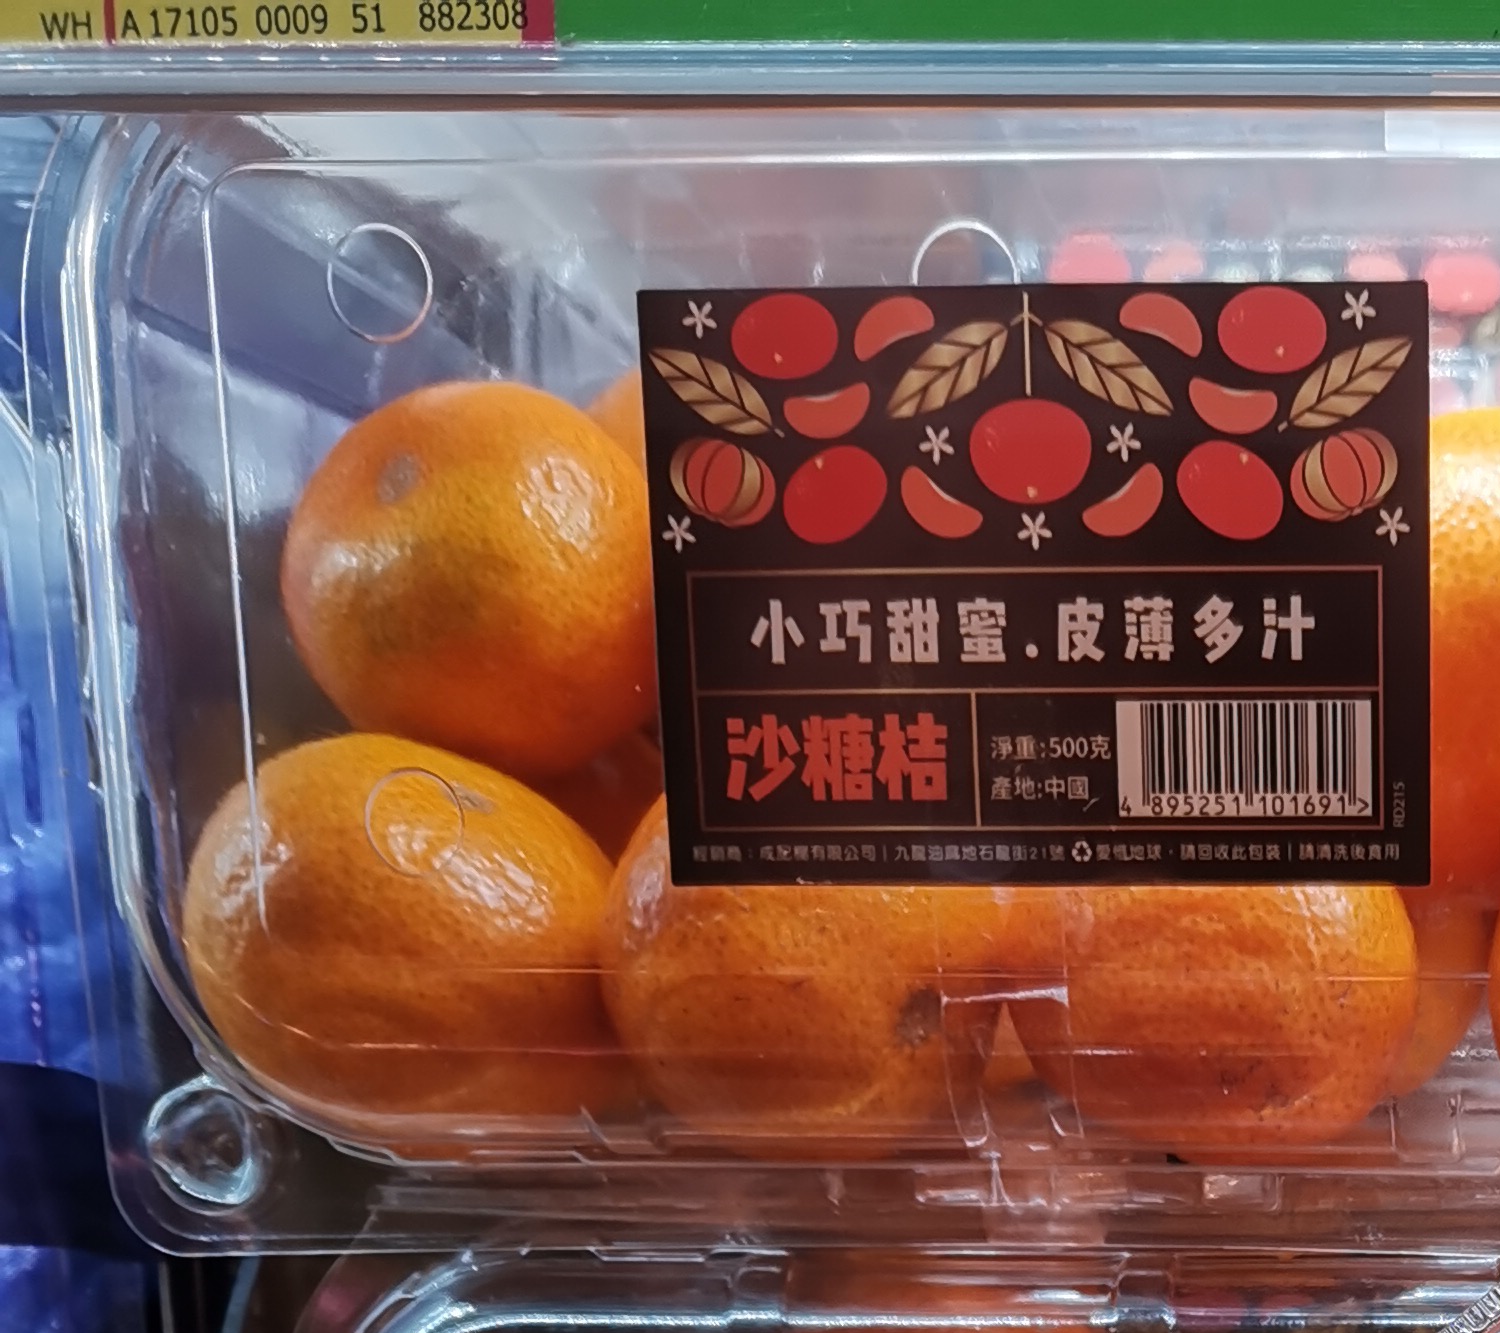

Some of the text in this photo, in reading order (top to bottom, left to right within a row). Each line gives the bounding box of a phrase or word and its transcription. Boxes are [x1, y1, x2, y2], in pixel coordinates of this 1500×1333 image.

[41, 11, 92, 40] WH
[255, 3, 328, 36] 0009
[351, 3, 385, 33] 51
[418, 0, 528, 32] 882308
[725, 712, 949, 802] 沙糖桔
[1120, 796, 1132, 816] 4
[1150, 796, 1243, 817] 895251
[1258, 796, 1348, 817] 101691
